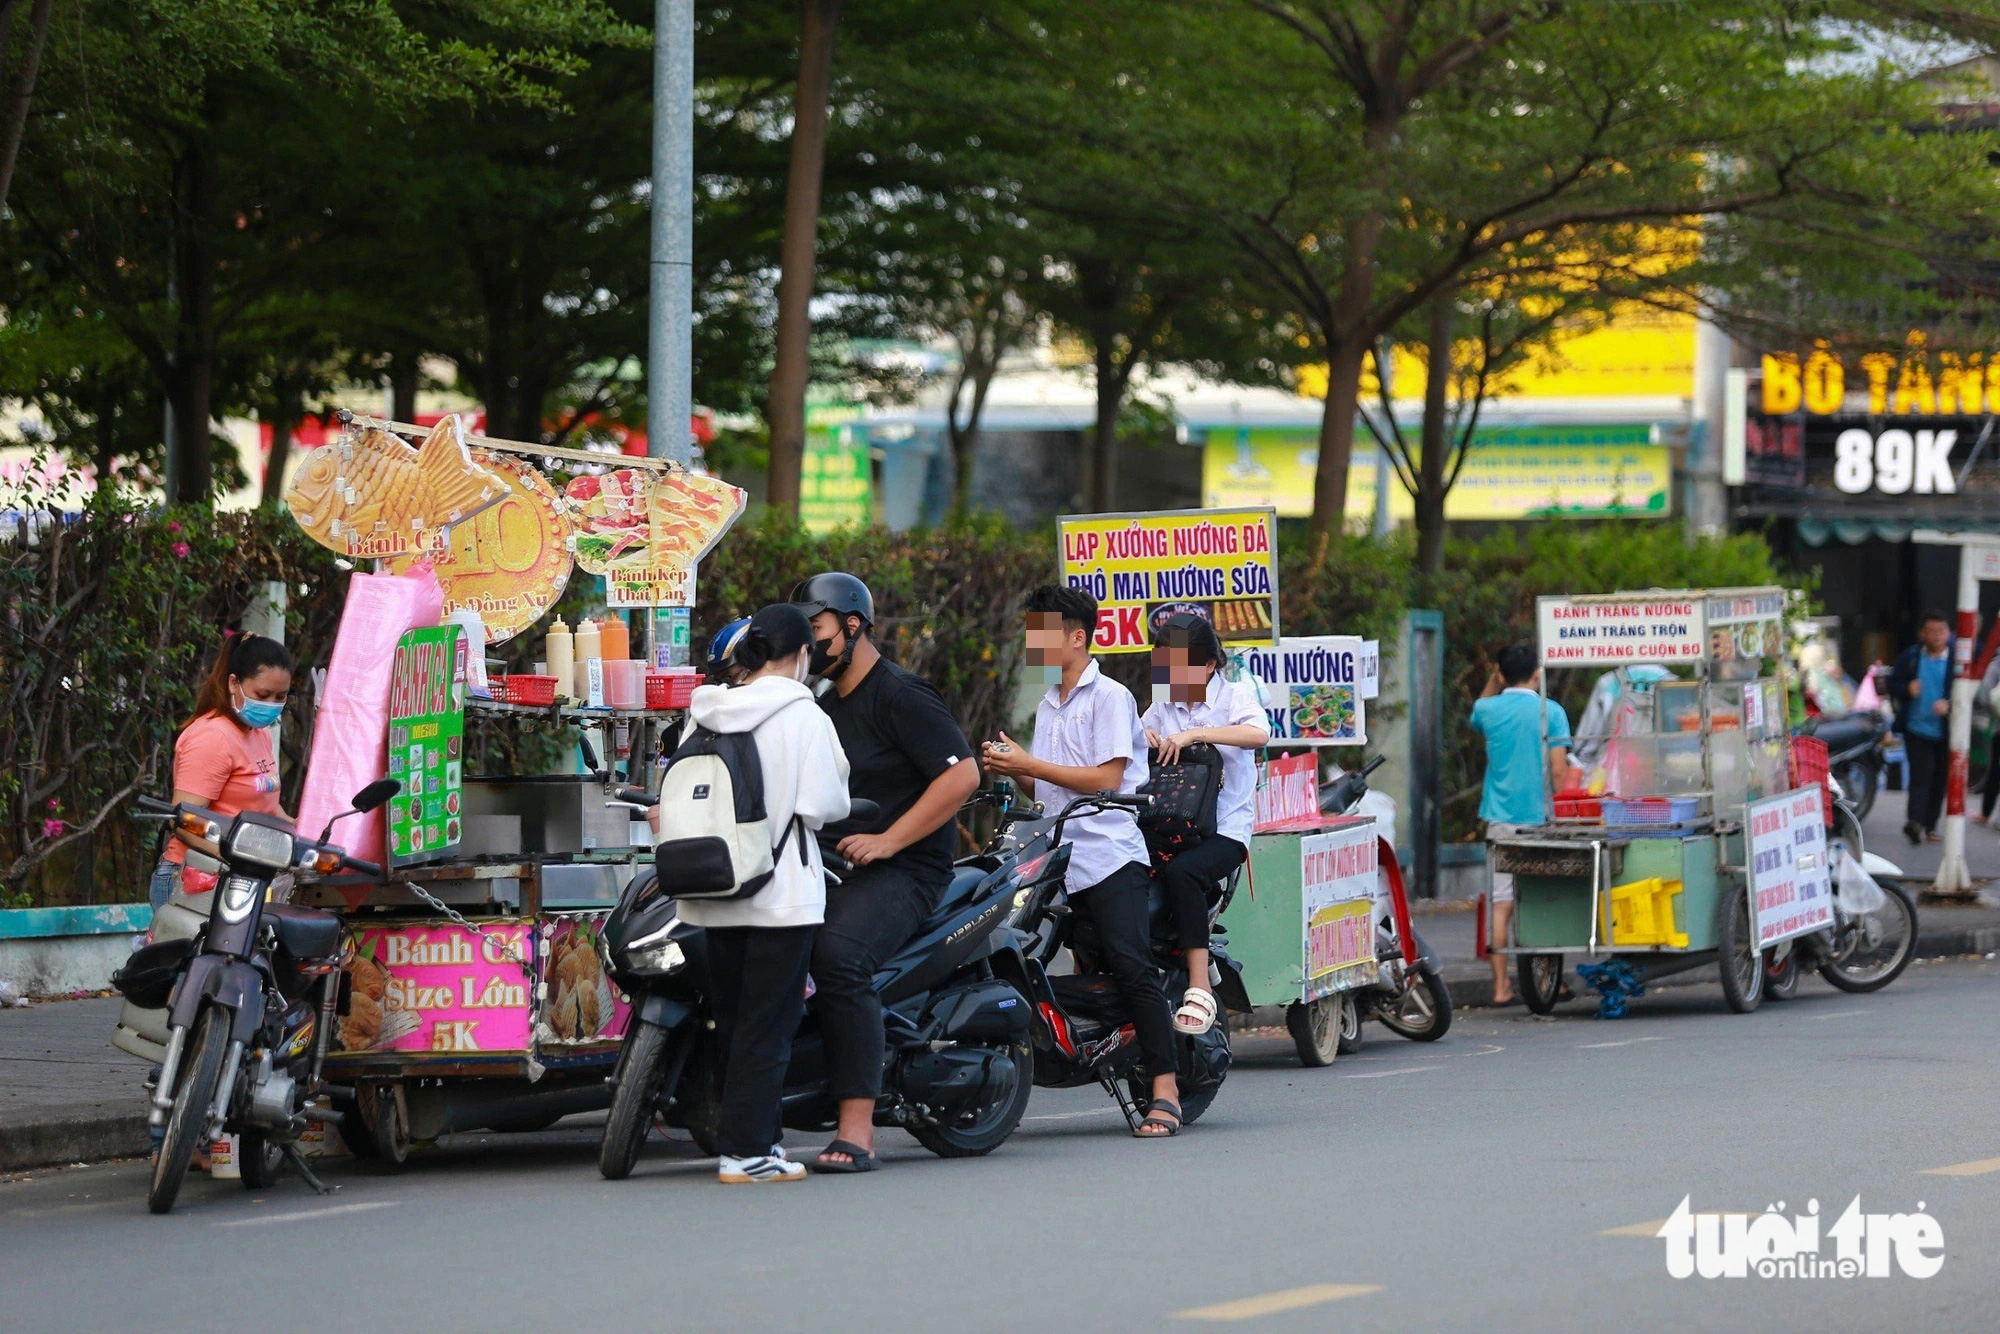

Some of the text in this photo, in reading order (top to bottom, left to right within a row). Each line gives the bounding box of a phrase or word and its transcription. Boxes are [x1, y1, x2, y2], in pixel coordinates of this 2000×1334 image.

[1834, 429, 1958, 494] 89K
[346, 526, 445, 556] Bánh Cá
[1065, 519, 1269, 566] LẠP XƯỞNG NƯỚNG ĐÁ
[611, 567, 654, 583] Bánh
[1113, 572, 1151, 601] MAI
[1157, 564, 1225, 599] NƯỚNG
[1231, 561, 1272, 597] SỮA
[467, 591, 519, 615] Đồng
[615, 586, 650, 602] Thái
[1553, 603, 1591, 619] BÁNH
[1595, 602, 1640, 618] TRÁNG
[1559, 621, 1688, 639] BÁNH TRÁNG TRỘN
[1284, 645, 1354, 684] NƯỚNG
[1547, 643, 1584, 659] BÁNH
[1589, 643, 1634, 658] TRÁNG
[1638, 641, 1677, 658] CUỘN
[391, 626, 449, 720] BÁNH CÁ
[385, 931, 526, 966] Bánh Cá
[384, 975, 527, 1011] Size Lớn
[432, 1020, 481, 1051] 5K
